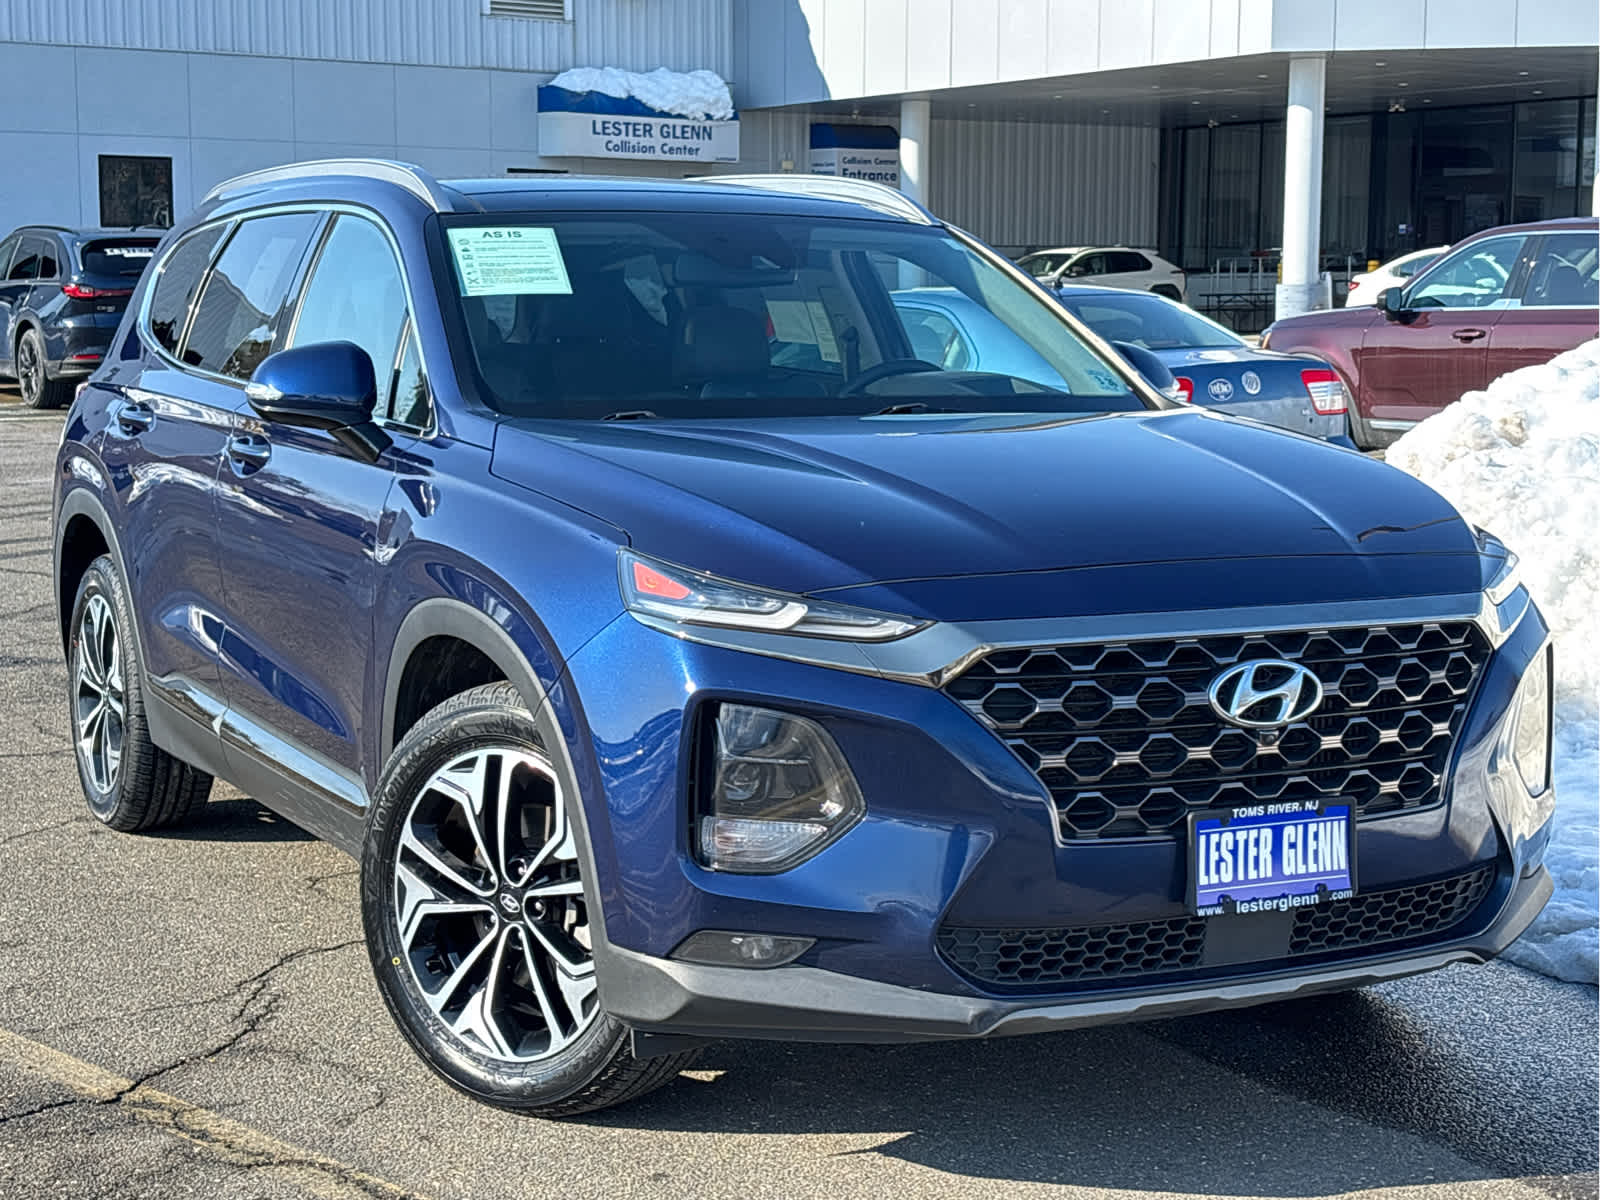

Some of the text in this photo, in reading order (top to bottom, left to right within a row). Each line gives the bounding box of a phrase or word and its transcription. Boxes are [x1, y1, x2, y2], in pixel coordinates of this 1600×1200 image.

[592, 119, 713, 141] LESTER GLENN
[604, 140, 701, 156] Collision Center
[842, 168, 897, 181] Entrance
[1232, 806, 1265, 819] TOMS
[1305, 799, 1319, 811] NJ
[1199, 820, 1346, 886] LESTER GLENN
[1236, 893, 1320, 914] lesterglenn
